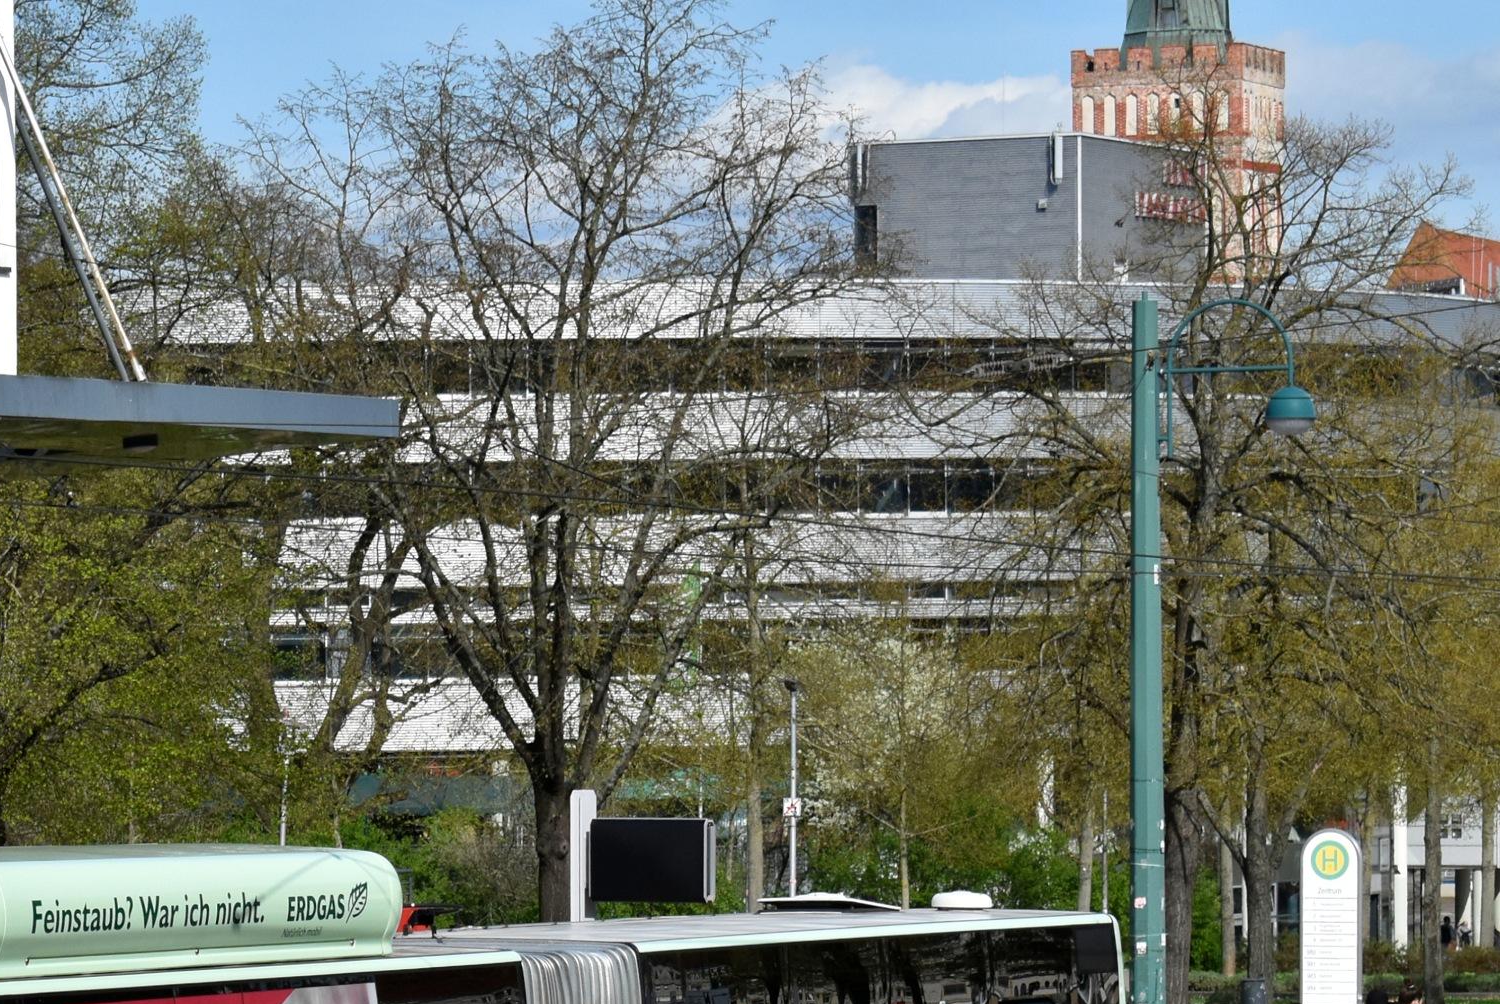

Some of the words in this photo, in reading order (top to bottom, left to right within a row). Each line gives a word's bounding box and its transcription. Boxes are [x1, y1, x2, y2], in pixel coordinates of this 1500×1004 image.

[1317, 887, 1342, 896] Zentrum
[31, 895, 134, 934] Feinstaub?
[139, 894, 179, 930] War
[184, 893, 211, 927] ich
[216, 891, 266, 926] nicht.
[287, 893, 346, 922] ERDGAS
